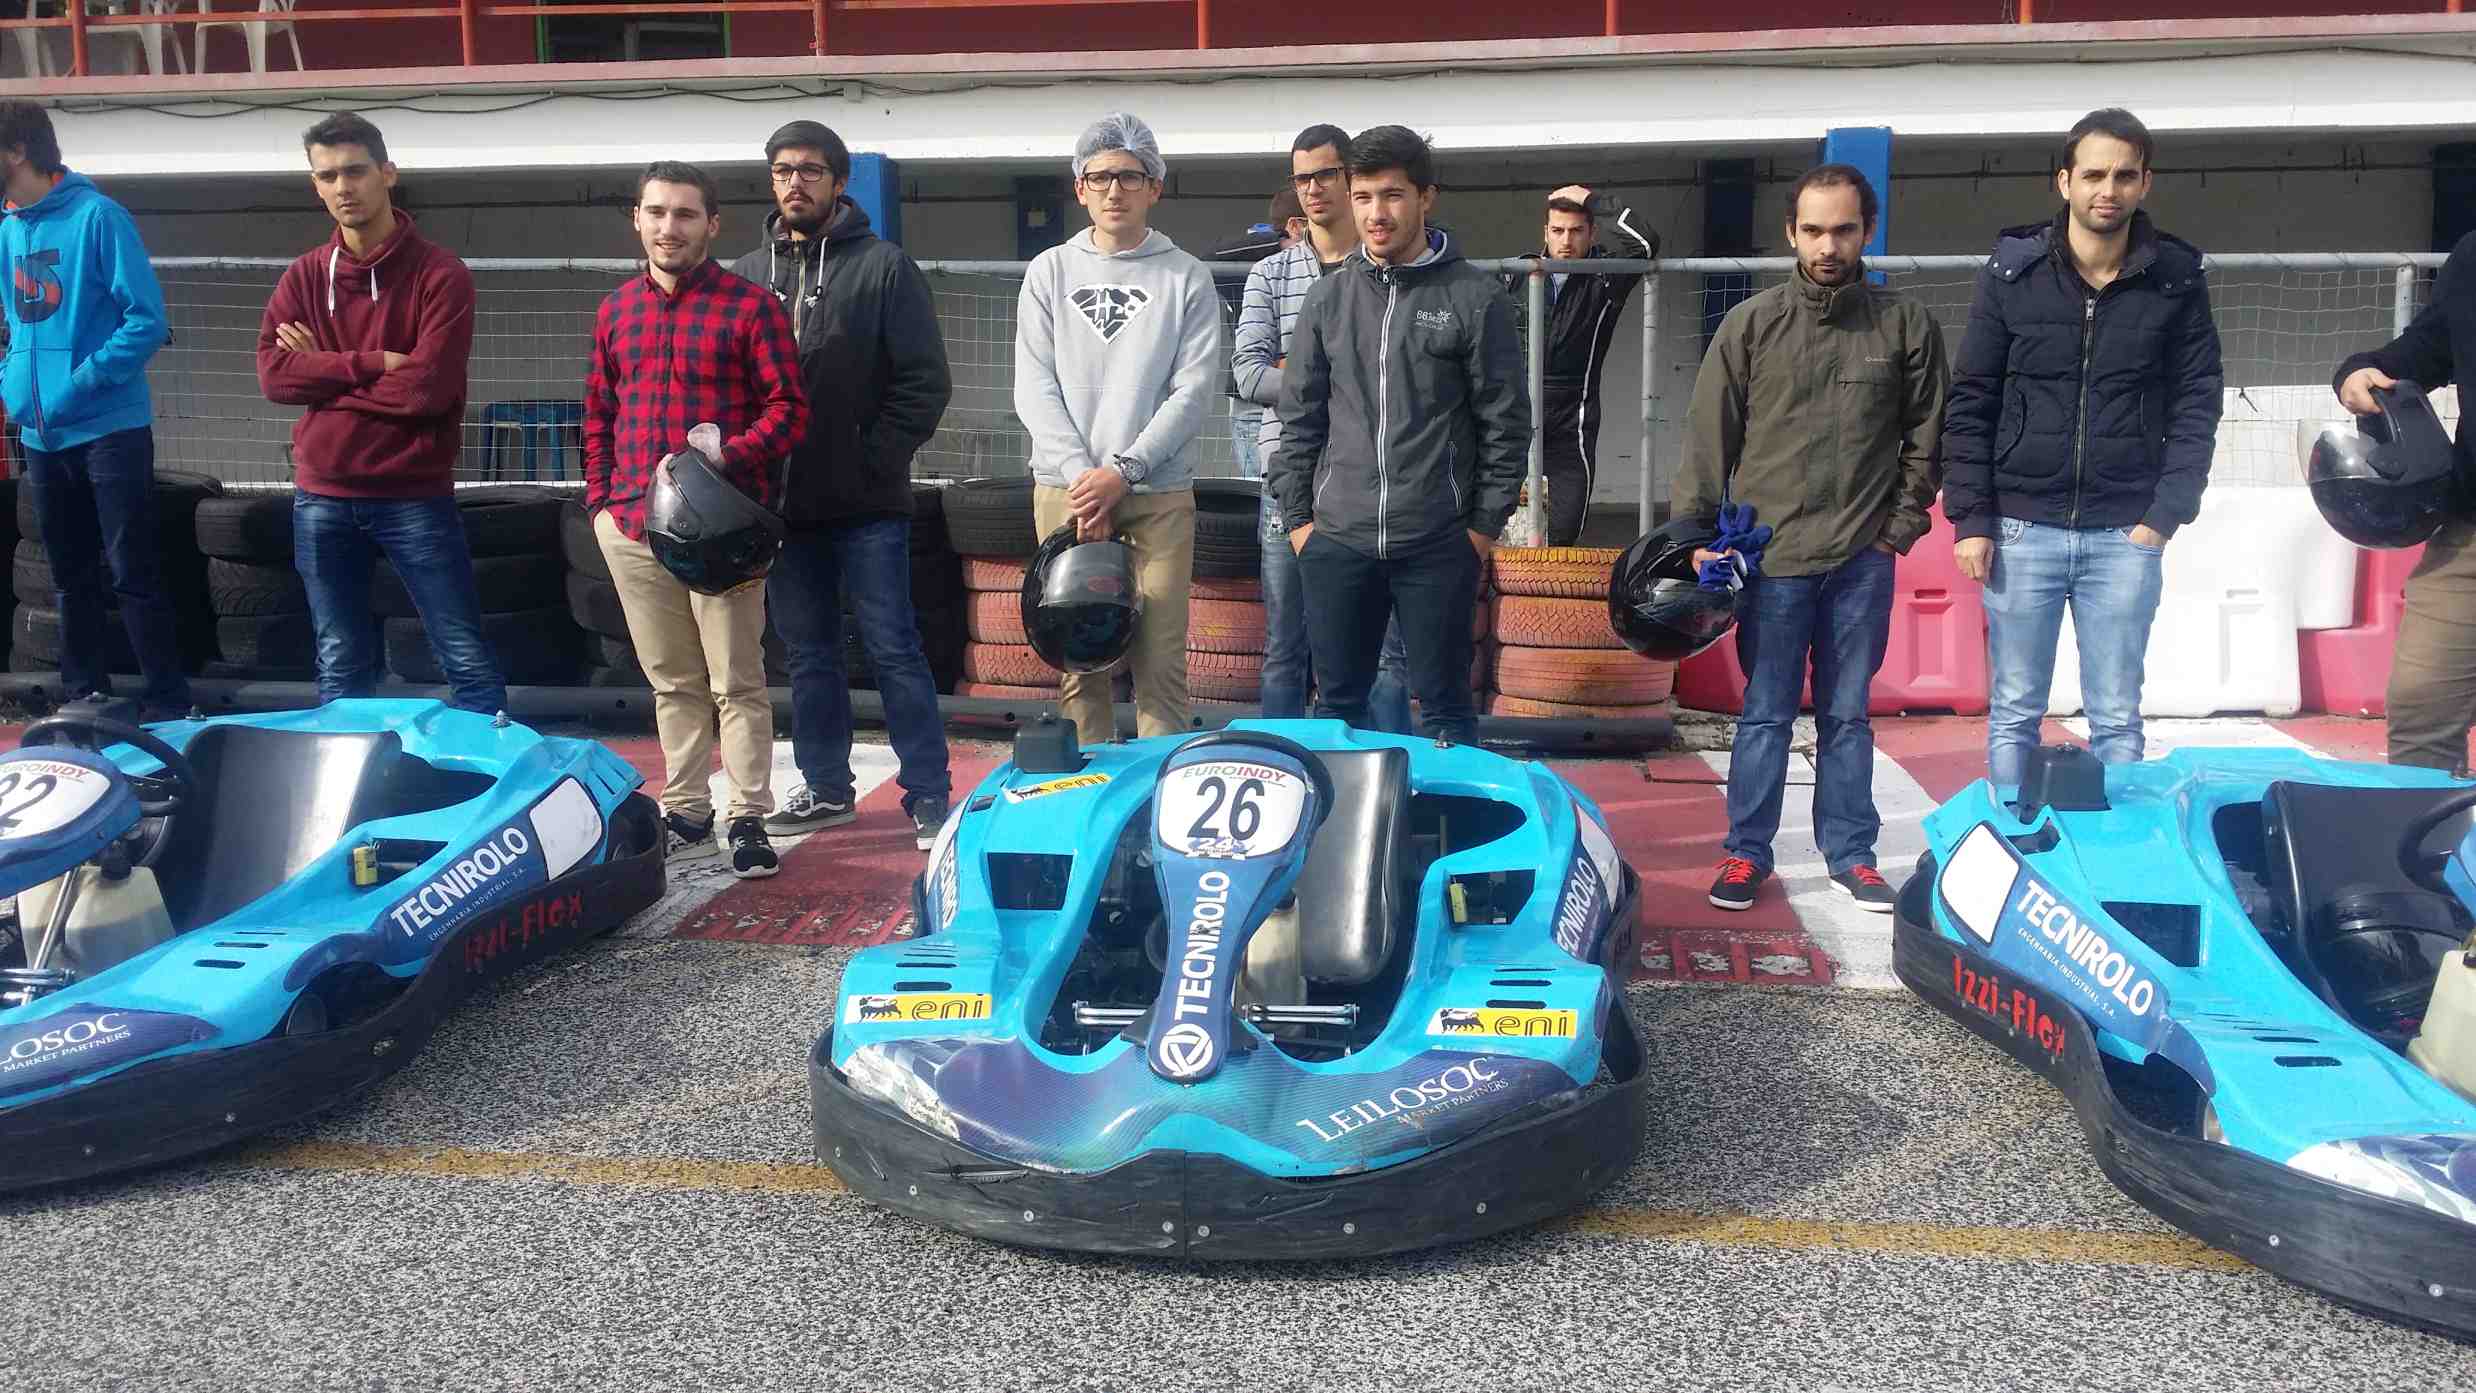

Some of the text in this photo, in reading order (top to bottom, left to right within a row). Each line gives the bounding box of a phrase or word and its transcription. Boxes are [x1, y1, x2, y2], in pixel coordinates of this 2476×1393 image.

[1054, 774, 1105, 790] eni
[1184, 765, 1287, 782] EUROINDY
[1187, 776, 1265, 841] 26
[391, 827, 529, 937] TECNIROLO
[1556, 857, 1596, 958] ECNIROLO
[1174, 871, 1231, 1021] TECNIROLO
[2016, 879, 2154, 1016] TECNIROLO
[911, 993, 984, 1020] eni
[1494, 1010, 1568, 1037] eni
[3, 1029, 131, 1073] MARKET PARTNERS
